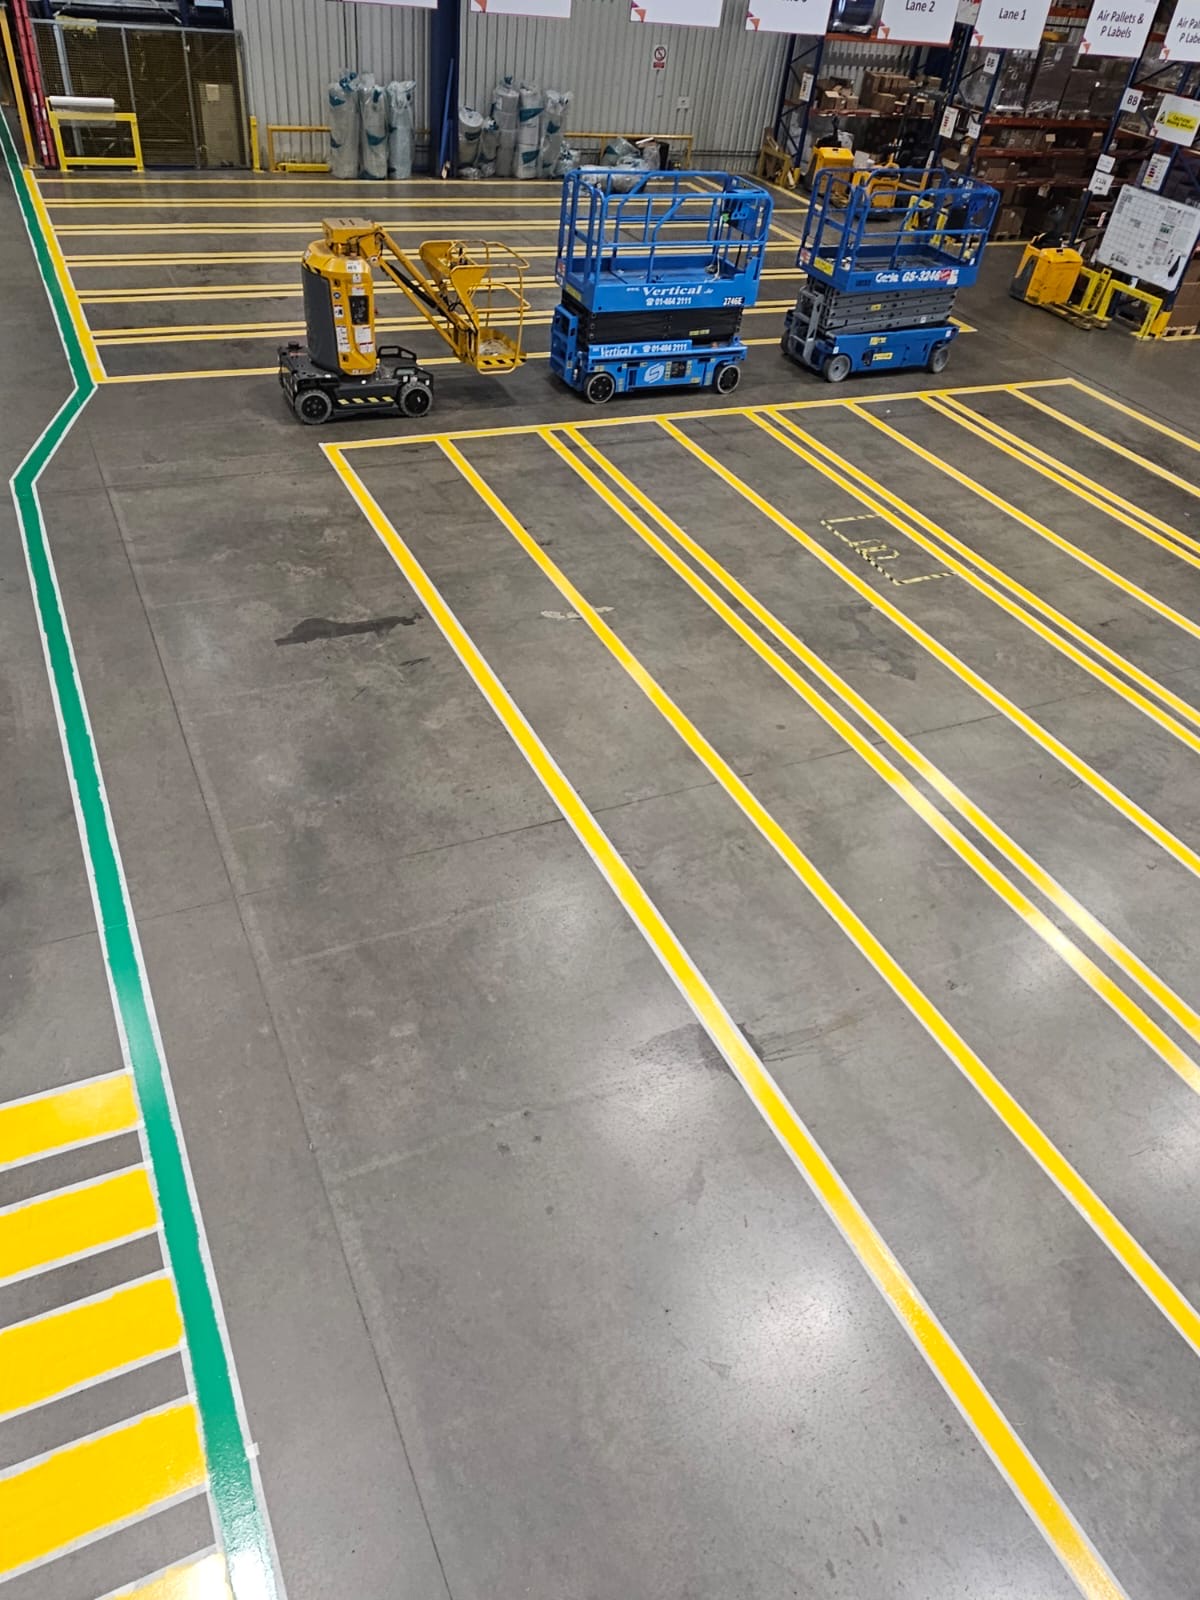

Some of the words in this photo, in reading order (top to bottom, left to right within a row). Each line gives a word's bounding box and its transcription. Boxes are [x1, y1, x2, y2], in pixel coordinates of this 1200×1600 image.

[905, 0, 927, 12] Lane
[928, 1, 935, 12] 2
[999, 8, 1021, 20] Lane
[1020, 9, 1027, 20] 1
[1097, 10, 1110, 21] Air
[1110, 11, 1136, 24] Pallets
[1137, 13, 1144, 24] &
[1177, 18, 1189, 29] Air
[1100, 26, 1107, 36] P
[1107, 26, 1132, 38] Labels
[1179, 32, 1186, 43] P
[643, 286, 702, 295] Vertical
[601, 346, 632, 356] Vertical
